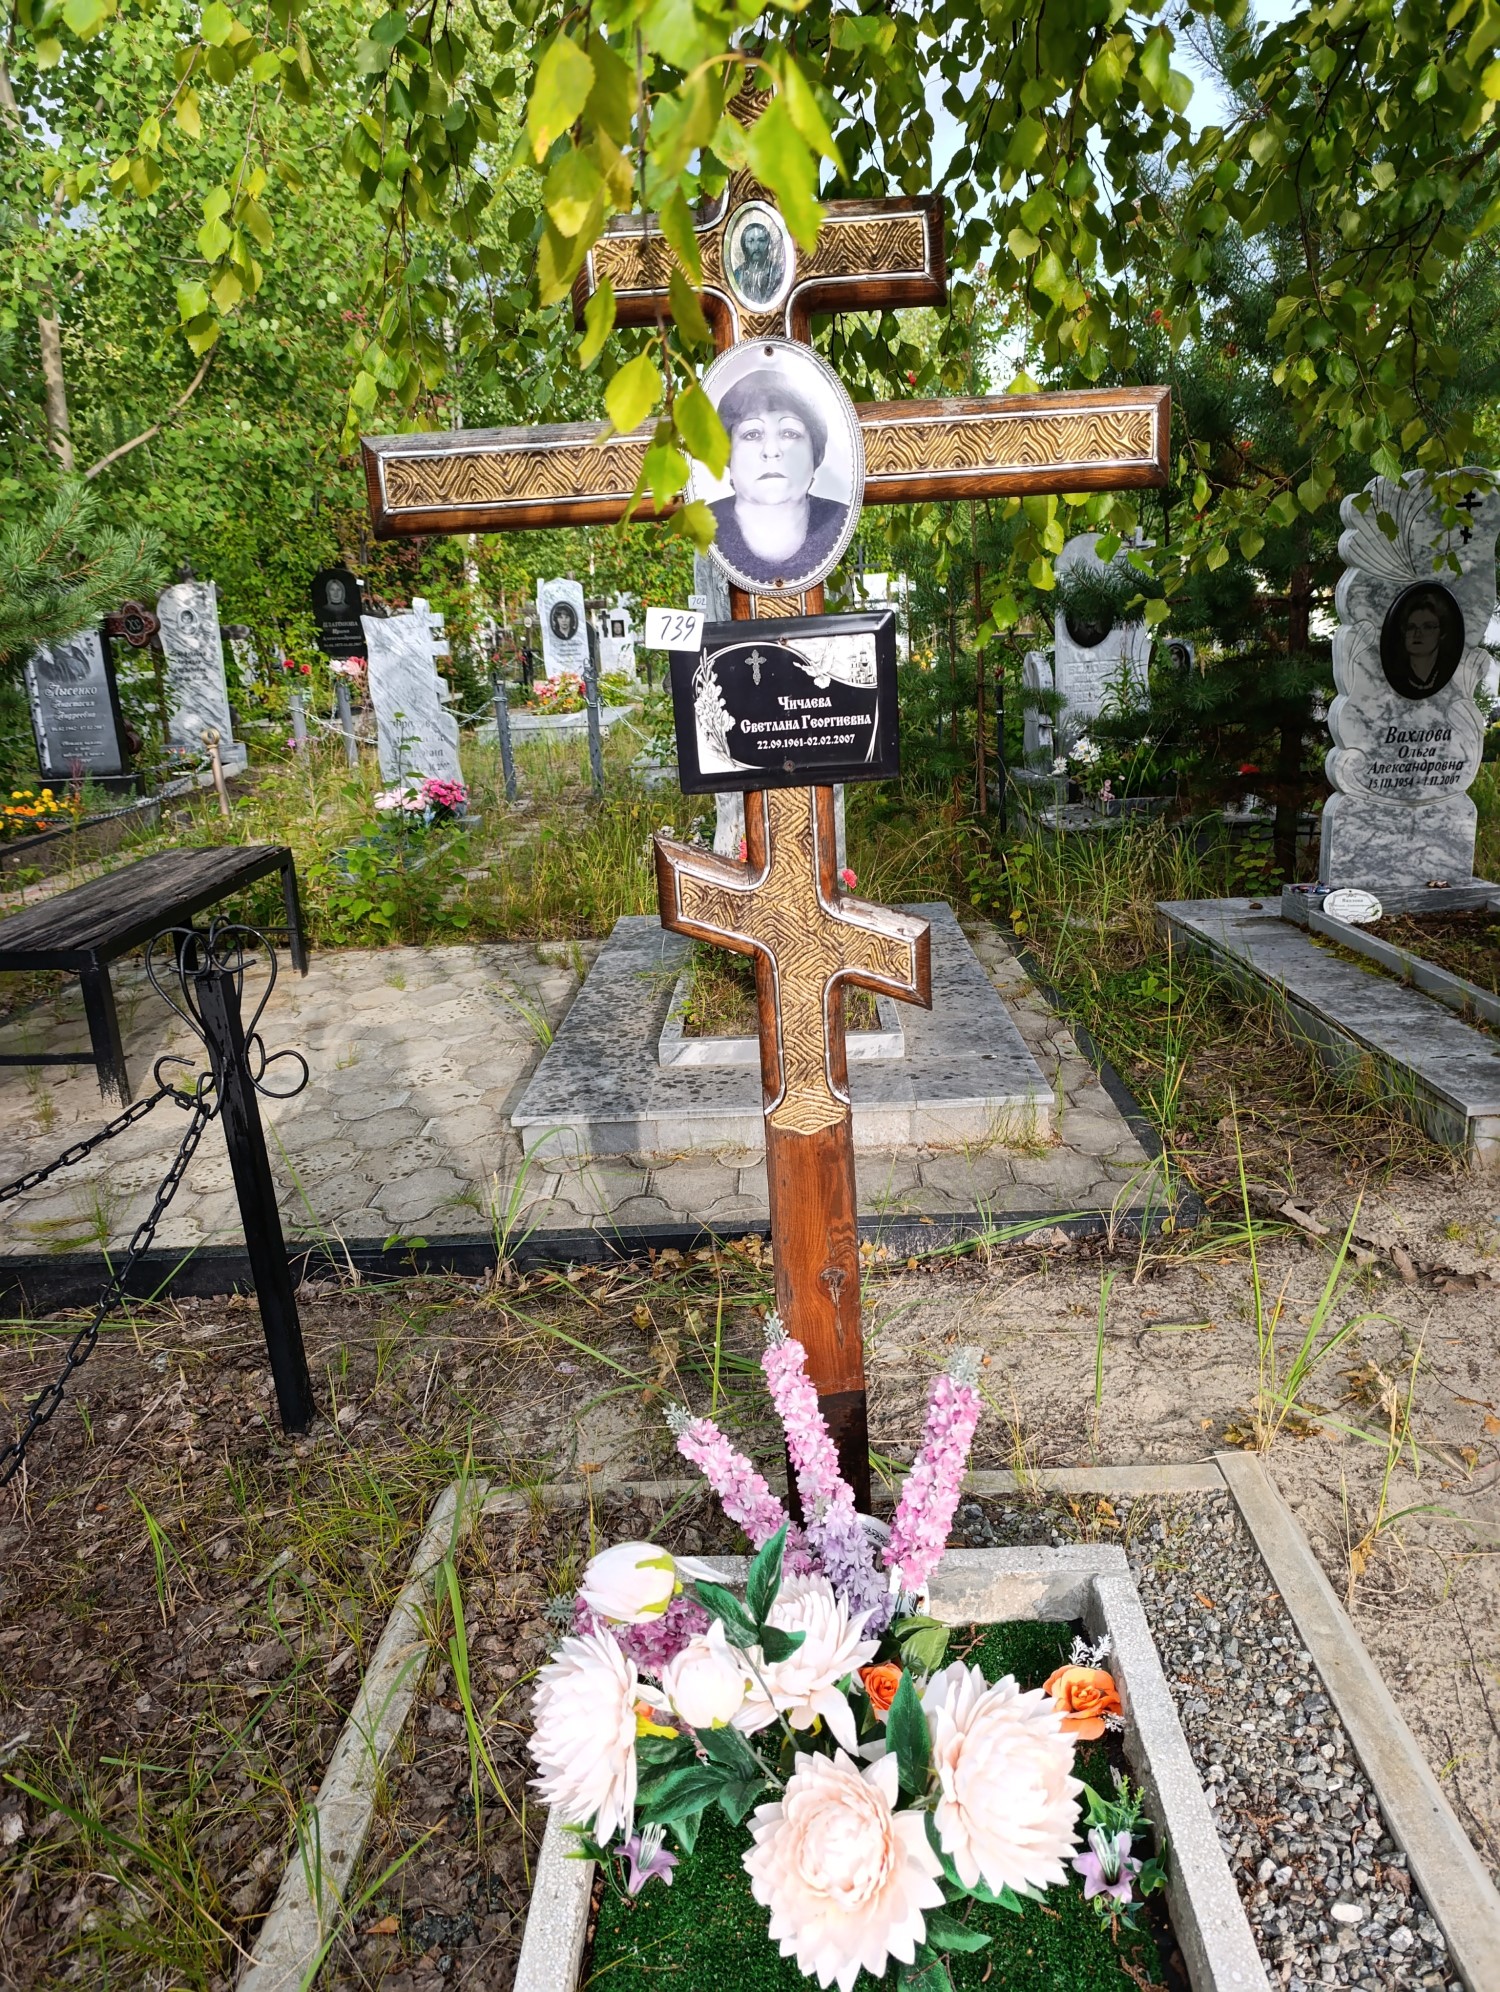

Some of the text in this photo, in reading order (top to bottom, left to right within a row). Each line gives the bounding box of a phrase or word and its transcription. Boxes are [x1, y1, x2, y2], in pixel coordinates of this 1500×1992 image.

[661, 615, 696, 641] 739
[44, 681, 98, 699] Лысенко
[777, 696, 832, 711] Чичаева
[740, 714, 872, 734] Светлана Георгиевна
[757, 734, 856, 750] 22.09.1961-02.02.2007
[1385, 726, 1452, 744] Вахлова
[1398, 745, 1437, 759] Ольга
[1367, 759, 1464, 775] Александровна
